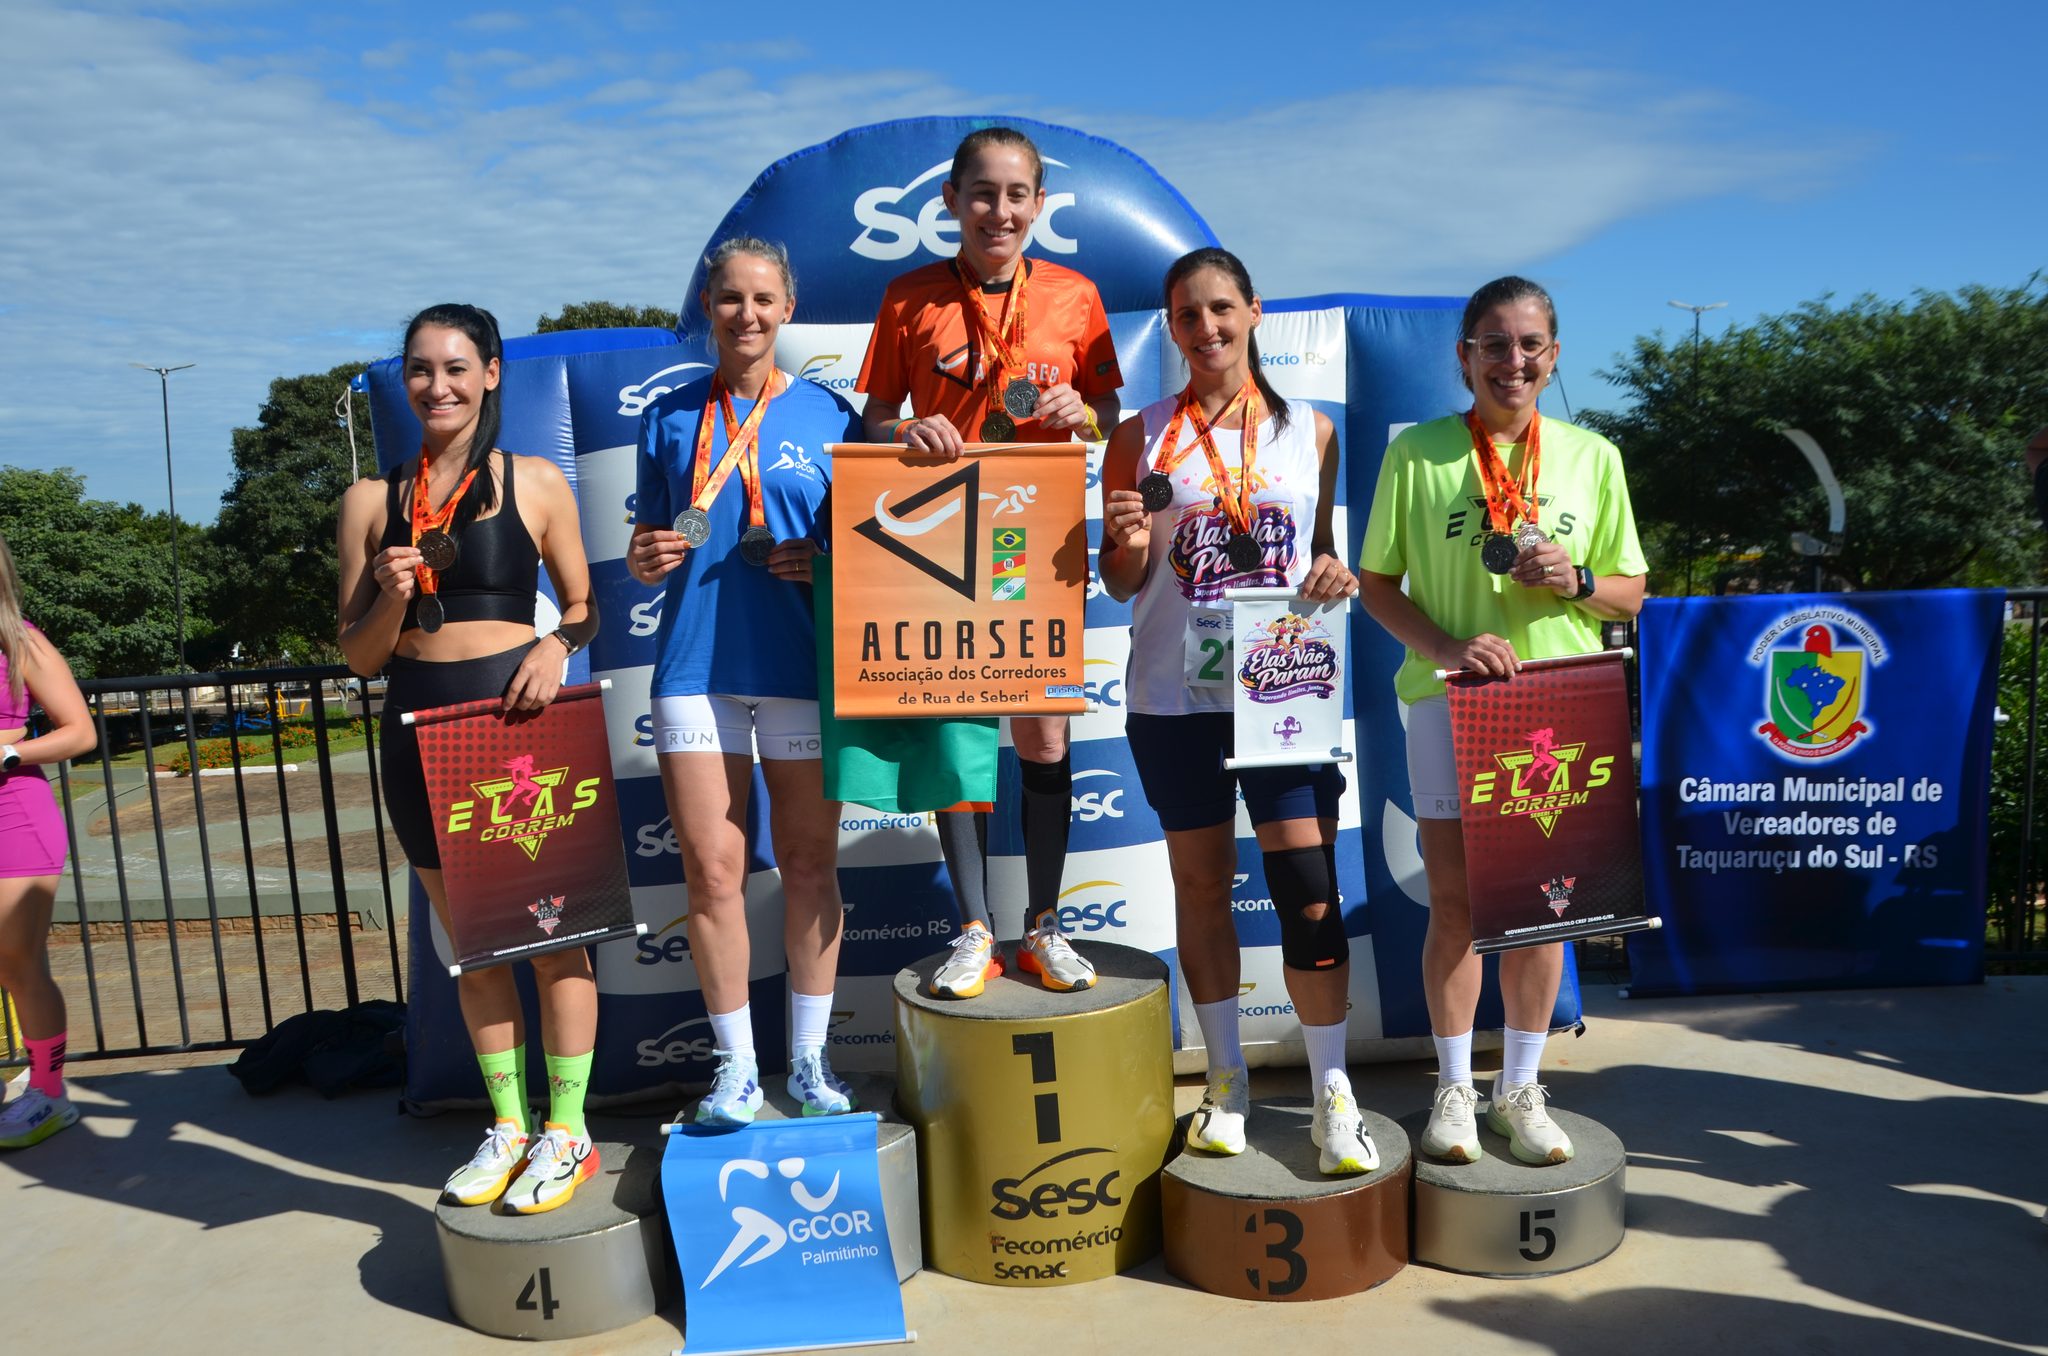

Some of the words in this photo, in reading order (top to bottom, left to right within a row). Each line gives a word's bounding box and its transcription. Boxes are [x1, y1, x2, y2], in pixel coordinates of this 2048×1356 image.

[850, 156, 1078, 260] Sec
[975, 362, 1060, 383] ASEB
[1260, 353, 1300, 366] ércio
[1305, 352, 1327, 365] RS
[794, 462, 816, 475] GCOR
[1181, 513, 1232, 555] Elas
[1445, 510, 1577, 540] ELS
[1190, 545, 1288, 583] Pam
[861, 618, 1066, 662] ACORSEB
[1753, 629, 1778, 661] PODER
[1777, 610, 1844, 632] LEGISLATIVO
[1846, 617, 1883, 661] MUNICIPAL
[1249, 648, 1290, 674] Elas
[1287, 645, 1328, 668] Não
[858, 666, 943, 685] Associação
[948, 665, 976, 680] dos
[981, 664, 1066, 680] Corredores
[1256, 662, 1331, 691] Param
[898, 692, 917, 705] de
[923, 691, 950, 704] Rua
[956, 690, 975, 703] de
[980, 689, 1029, 703] Seberi
[668, 731, 713, 745] RUN
[1471, 755, 1615, 804] ELAS
[1679, 777, 1776, 803] Câmara
[1783, 777, 1905, 807] Municipal
[1911, 778, 1943, 802] de
[447, 777, 601, 833] ELAS
[1435, 798, 1460, 813] RU
[1500, 790, 1590, 816] CORREM
[480, 813, 576, 842] CORREM
[839, 814, 922, 831] ecomércio
[1724, 812, 1860, 836] Vereadores
[1866, 811, 1897, 835] de
[1676, 845, 1801, 874] Taquaruçu
[1807, 845, 1838, 869] do
[1844, 845, 1883, 868] Sul
[1904, 845, 1938, 868] RS
[842, 923, 922, 941] comércio
[927, 919, 951, 936] RS
[1057, 900, 1127, 934] esc
[636, 1019, 717, 1067] Ses
[1012, 1031, 1061, 1144] 1
[788, 1210, 873, 1243] GCOR
[990, 1226, 1123, 1256] Fecomércio
[1518, 1209, 1557, 1262] 5
[801, 1244, 879, 1266] Palmitinho
[1245, 1208, 1308, 1295] 3
[993, 1261, 1066, 1280] Senac
[516, 1267, 560, 1321] 4
